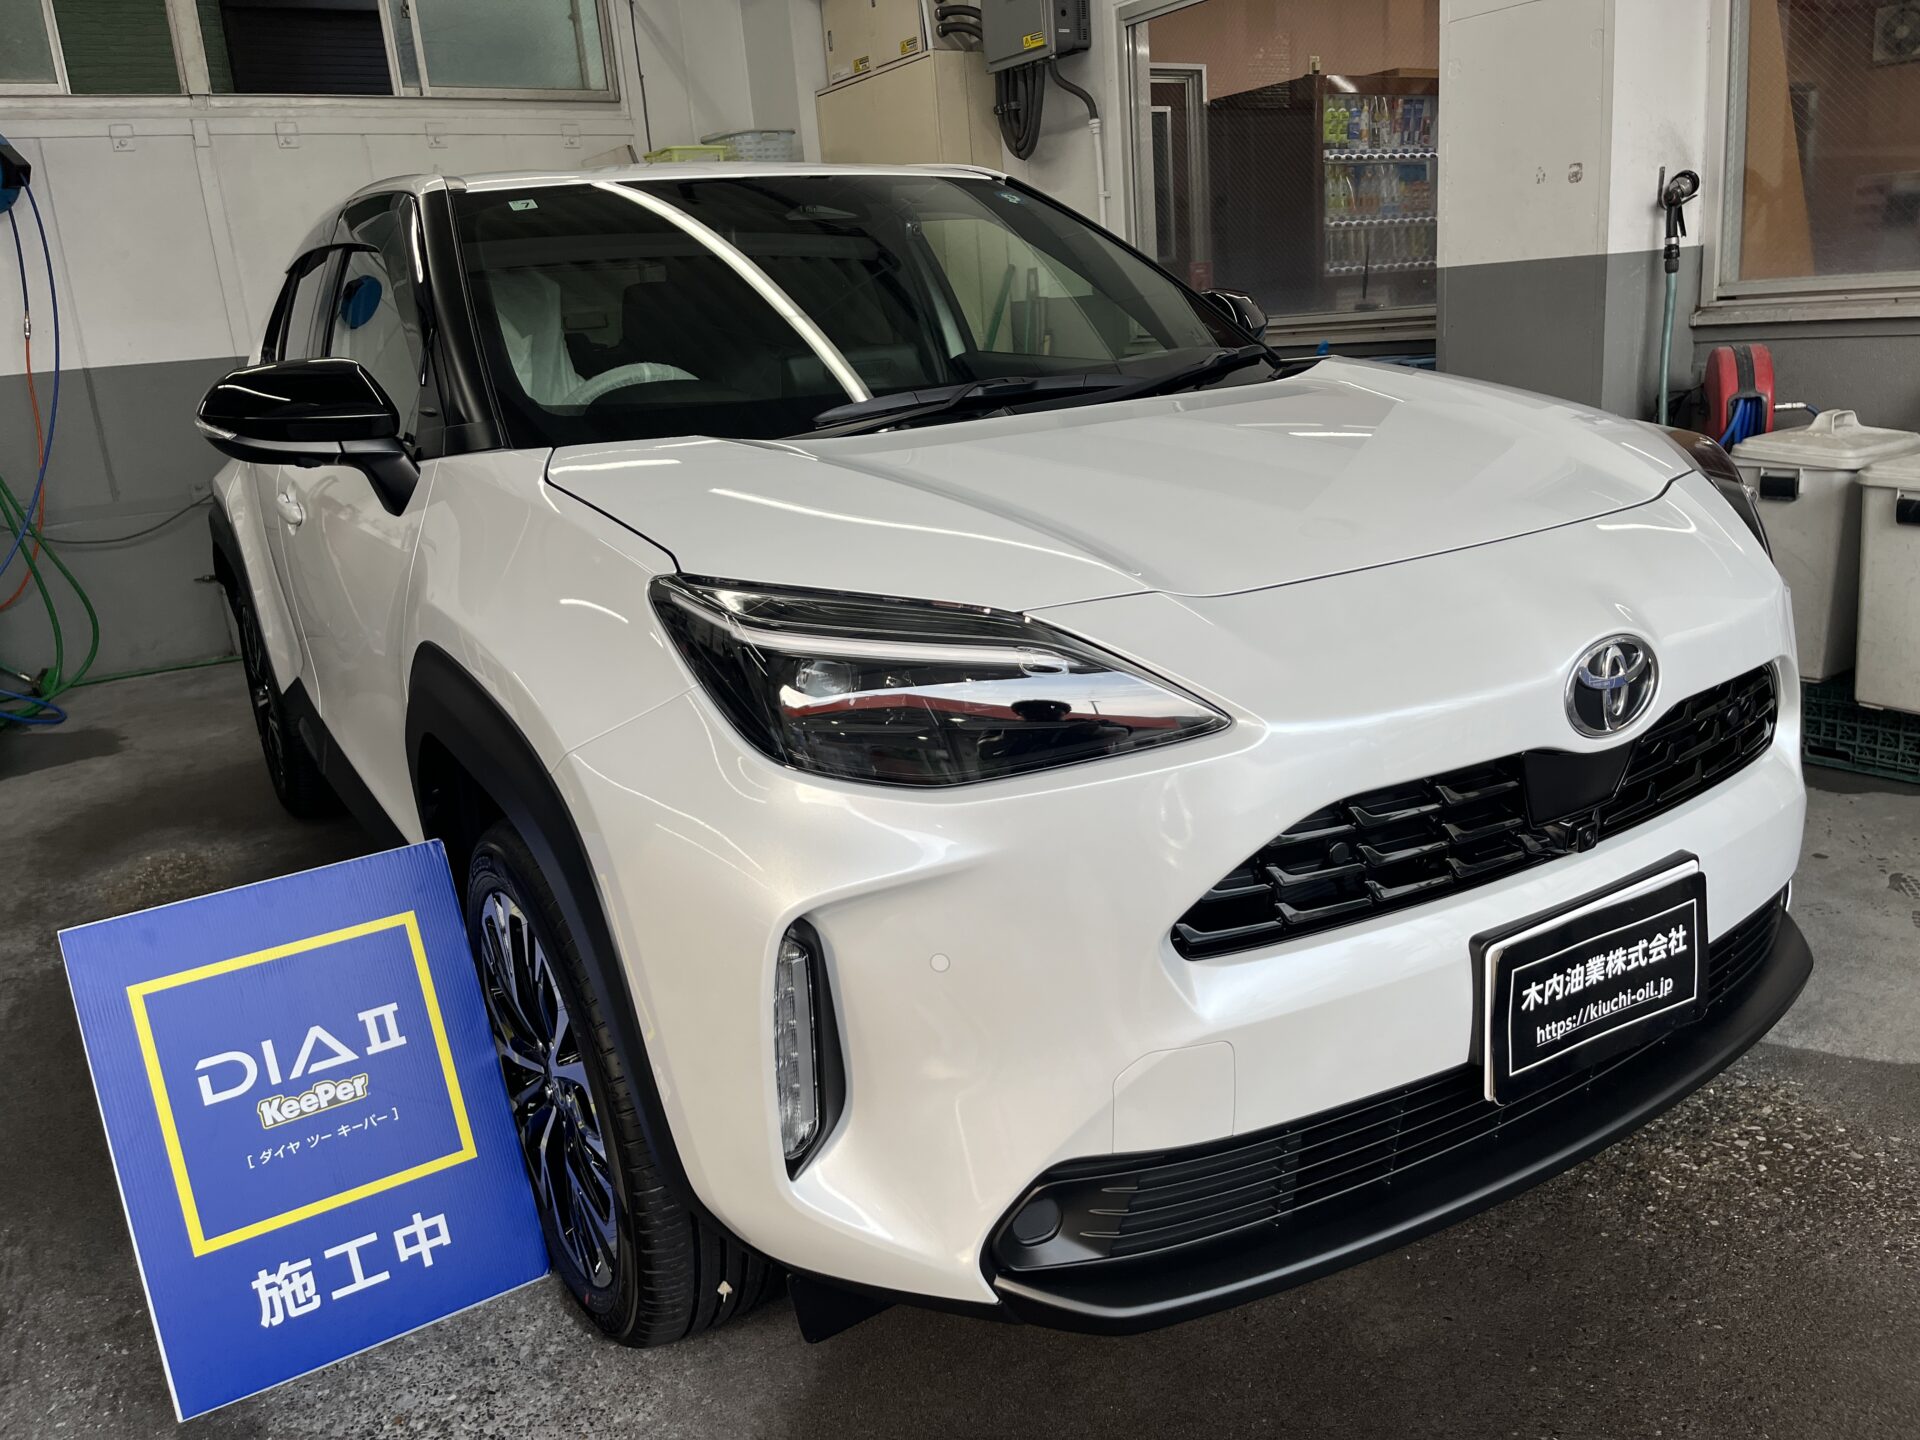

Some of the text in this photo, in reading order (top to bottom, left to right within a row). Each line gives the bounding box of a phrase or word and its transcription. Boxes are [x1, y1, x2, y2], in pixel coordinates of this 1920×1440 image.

[1520, 923, 1688, 1012] 木内油業株式会社
[1536, 976, 1674, 1046] https://kiuchi-oil.jp
[194, 1024, 360, 1107] DIA
[258, 1073, 368, 1129] KeePer
[259, 1140, 301, 1165] ダイヤ
[306, 1132, 332, 1149] ツー
[251, 1212, 452, 1329] 施工中
